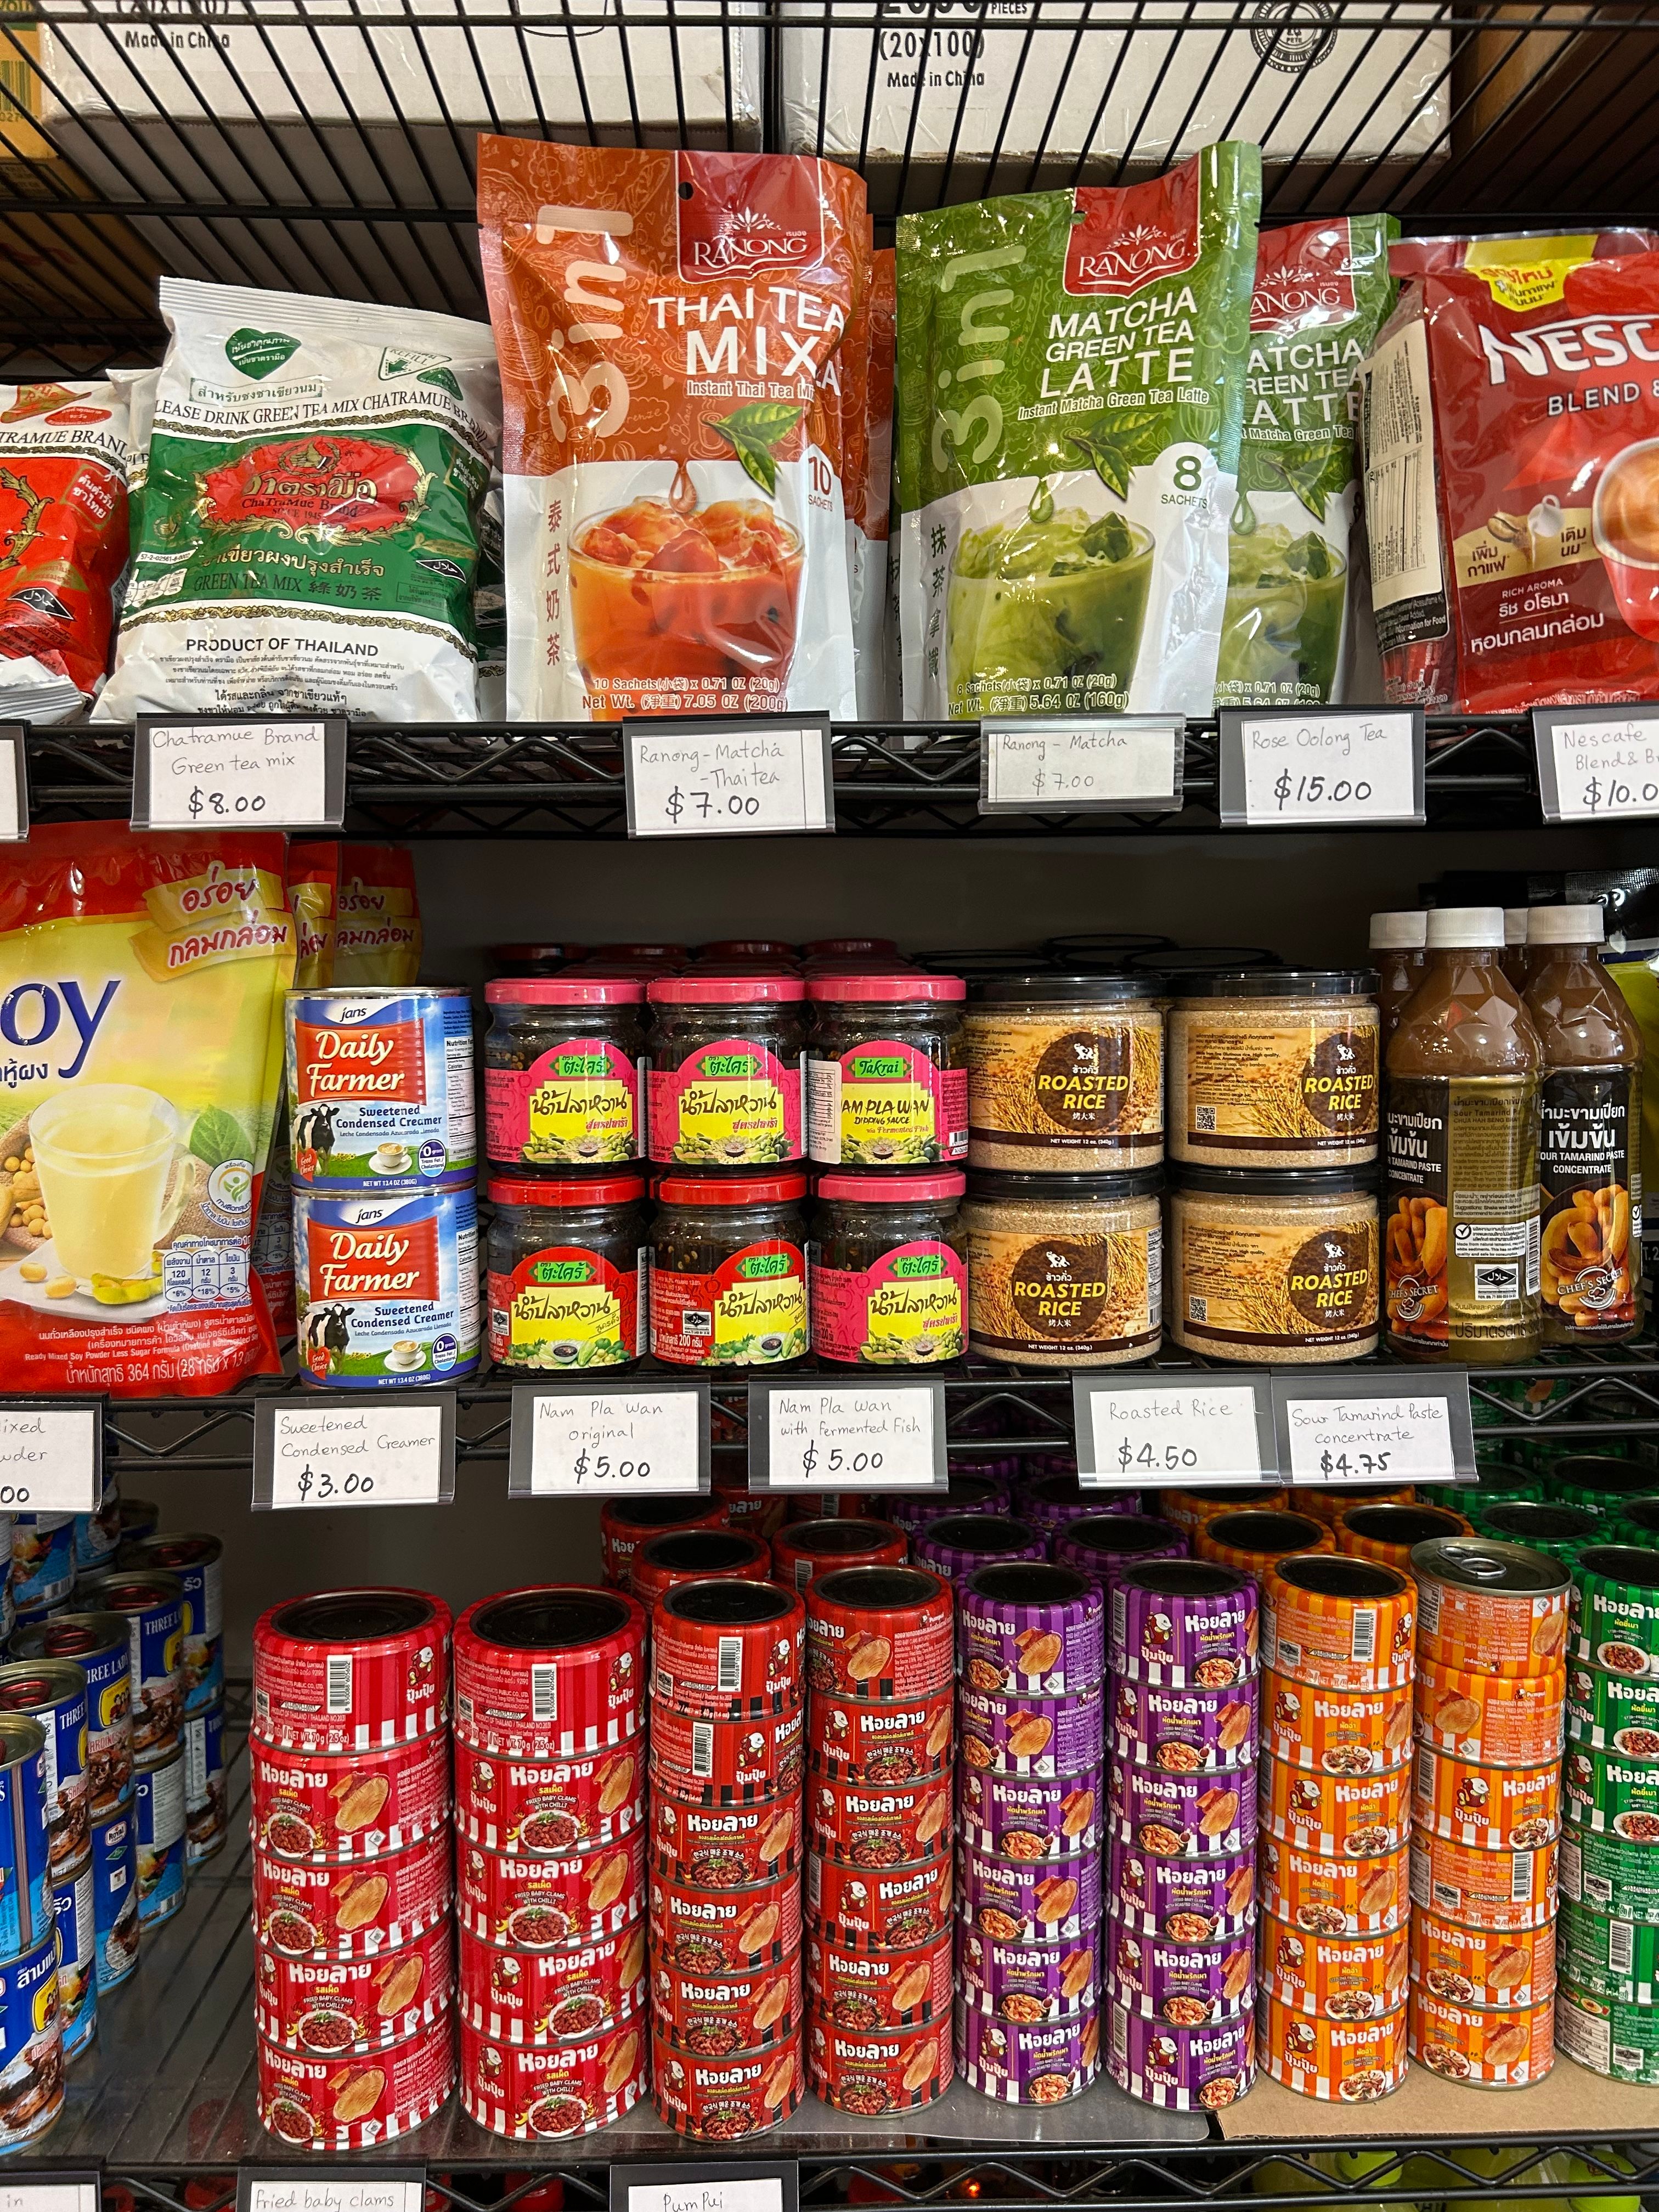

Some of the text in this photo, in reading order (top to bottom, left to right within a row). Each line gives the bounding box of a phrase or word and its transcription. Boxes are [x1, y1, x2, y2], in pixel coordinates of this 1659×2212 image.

[693, 235, 808, 266] RANONG
[1078, 239, 1187, 278] RANONG
[648, 286, 845, 337] THAI TEA
[1048, 287, 1198, 340] MATCHA
[686, 326, 819, 378] MIX
[1046, 324, 1195, 364] GREEN TEA
[1040, 347, 1195, 399] LATTE
[687, 380, 794, 397] Instant Thai Tea
[1547, 382, 1640, 416] BLEND
[204, 391, 452, 425] DRINK GREEN TEA MIX CHATRAMUE
[1018, 387, 1209, 421] Instant Matcha Green Tea Latte
[808, 456, 831, 495] 10
[1173, 455, 1203, 492] 8
[808, 494, 833, 512] SACHETS
[1161, 493, 1209, 509] SACHETS
[546, 500, 562, 666] 泰式奶茶
[1502, 578, 1564, 599] RICH AROMA
[1499, 591, 1569, 618] ริช อโรมา
[1470, 612, 1604, 653] หอมกลมกล่อม
[187, 638, 378, 656] PRODUCT OF THAILAND
[594, 677, 780, 693] 10 0.71 OZ (20g)
[1043, 673, 1118, 691] 0.71 OZ (20g)
[583, 695, 606, 709] Net
[611, 695, 634, 709] Wt.
[685, 694, 716, 708] 7.05
[722, 694, 740, 709] OZ
[948, 691, 1129, 715] Net Wt. 5.64 OZ (160g)
[153, 726, 319, 748] Chatramue Brand
[1003, 730, 1128, 761] Ranong Matcha
[1252, 723, 1387, 755] Rose Oolong Tea
[1564, 722, 1646, 749] Nescafe
[172, 752, 295, 775] Green tea mix
[1032, 768, 1094, 796] $7.00
[1274, 768, 1372, 810] $15.00
[188, 785, 266, 819] $8.00
[665, 786, 760, 823] $7.00
[182, 866, 257, 913] อร่อย
[170, 910, 288, 969] กลมกล่อม
[340, 1007, 367, 1022] jans
[315, 1031, 394, 1065] Daily
[860, 1059, 899, 1076] Takrai
[306, 1063, 405, 1097] Farmer
[1037, 1074, 1128, 1092] ROASTED
[1304, 1074, 1373, 1093] ROASTED
[359, 1105, 420, 1116] Sweetened
[532, 1088, 628, 1115] น้ำปลาหวาน
[866, 1099, 929, 1115] PLA WAN
[1063, 1093, 1106, 1110] RICE
[1328, 1093, 1361, 1111] RICE
[336, 1116, 442, 1128] Condensed Creamer
[1560, 1149, 1625, 1161] TAMARIND PASTE
[1553, 1164, 1612, 1175] CONCENTRATE
[356, 1208, 383, 1223] jans
[330, 1232, 409, 1266] Daily
[319, 1263, 420, 1297] Farmer
[1014, 1281, 1106, 1299] ROASTED
[515, 1294, 611, 1321] น้ำปลาหวาน
[871, 1288, 957, 1316] น้ำปลาหวาน
[1039, 1301, 1081, 1317] RICE
[70, 1348, 150, 1361] Soy Powder Less Sugar
[128, 1364, 149, 1381] 364
[540, 1402, 574, 1419] Nam
[591, 1400, 614, 1417] Pla
[780, 1398, 811, 1414] Nam
[821, 1397, 844, 1414] Pla
[1110, 1398, 1233, 1420] Roasted Rice
[1292, 1403, 1443, 1427] Sour Tamarind Paste
[280, 1415, 368, 1435] Sweetened
[781, 1420, 808, 1436] with
[281, 1435, 436, 1457] Condensed Creamer
[1119, 1437, 1197, 1473] $4.50
[574, 1448, 650, 1484] $5.00
[803, 1439, 883, 1478] $5.00
[1320, 1449, 1391, 1481] $4.75
[298, 1464, 374, 1501] $3.00
[1148, 1694, 1217, 1714] หอยลาย
[860, 1711, 926, 1732] หอยลาย
[510, 1762, 593, 1786] หอยลาย
[289, 1962, 373, 1984] หอยลาย
[1330, 2022, 1393, 2047] หอยลาย
[305, 2188, 394, 2212] baby clams
